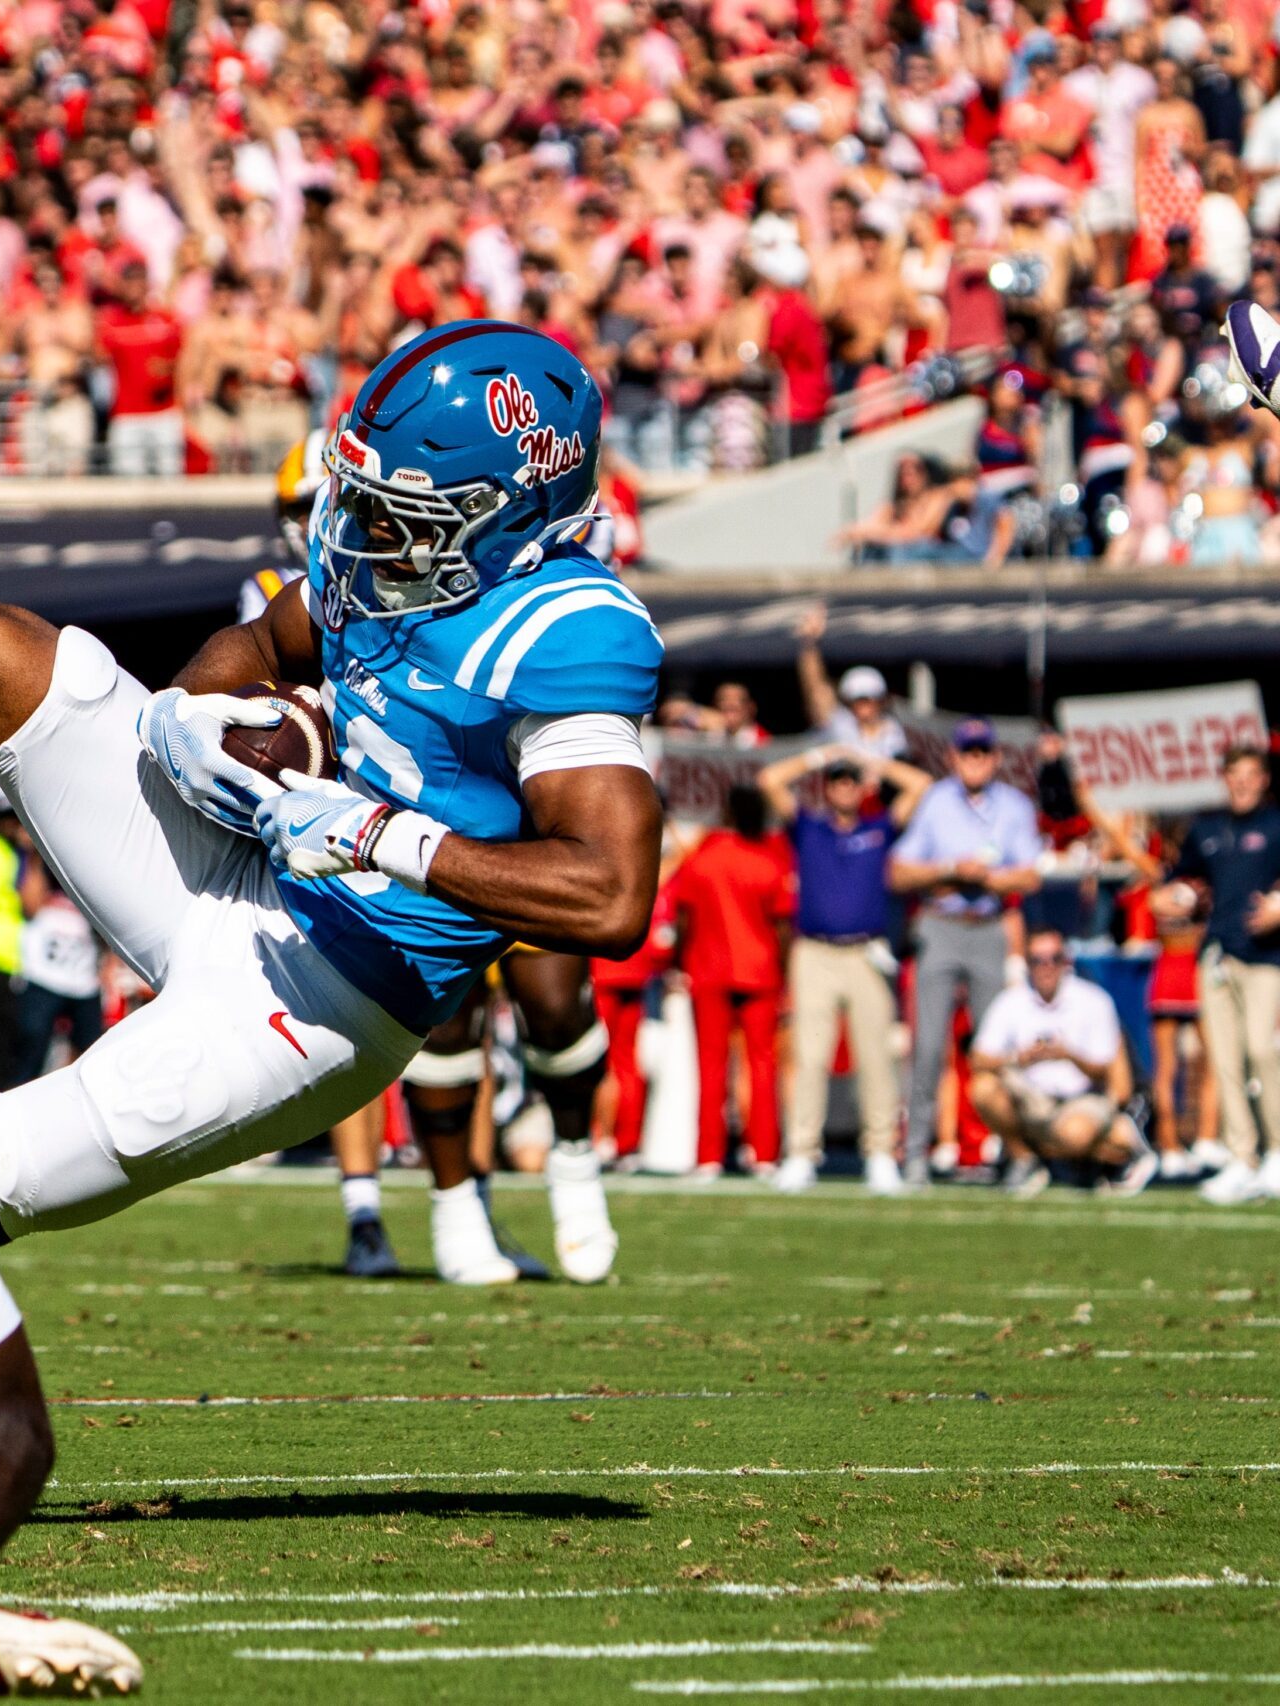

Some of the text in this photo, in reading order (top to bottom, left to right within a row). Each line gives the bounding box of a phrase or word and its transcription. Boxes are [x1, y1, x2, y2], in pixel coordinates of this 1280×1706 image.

[486, 373, 539, 437] Ole
[396, 472, 428, 482] TODDY
[517, 425, 586, 489] Miss
